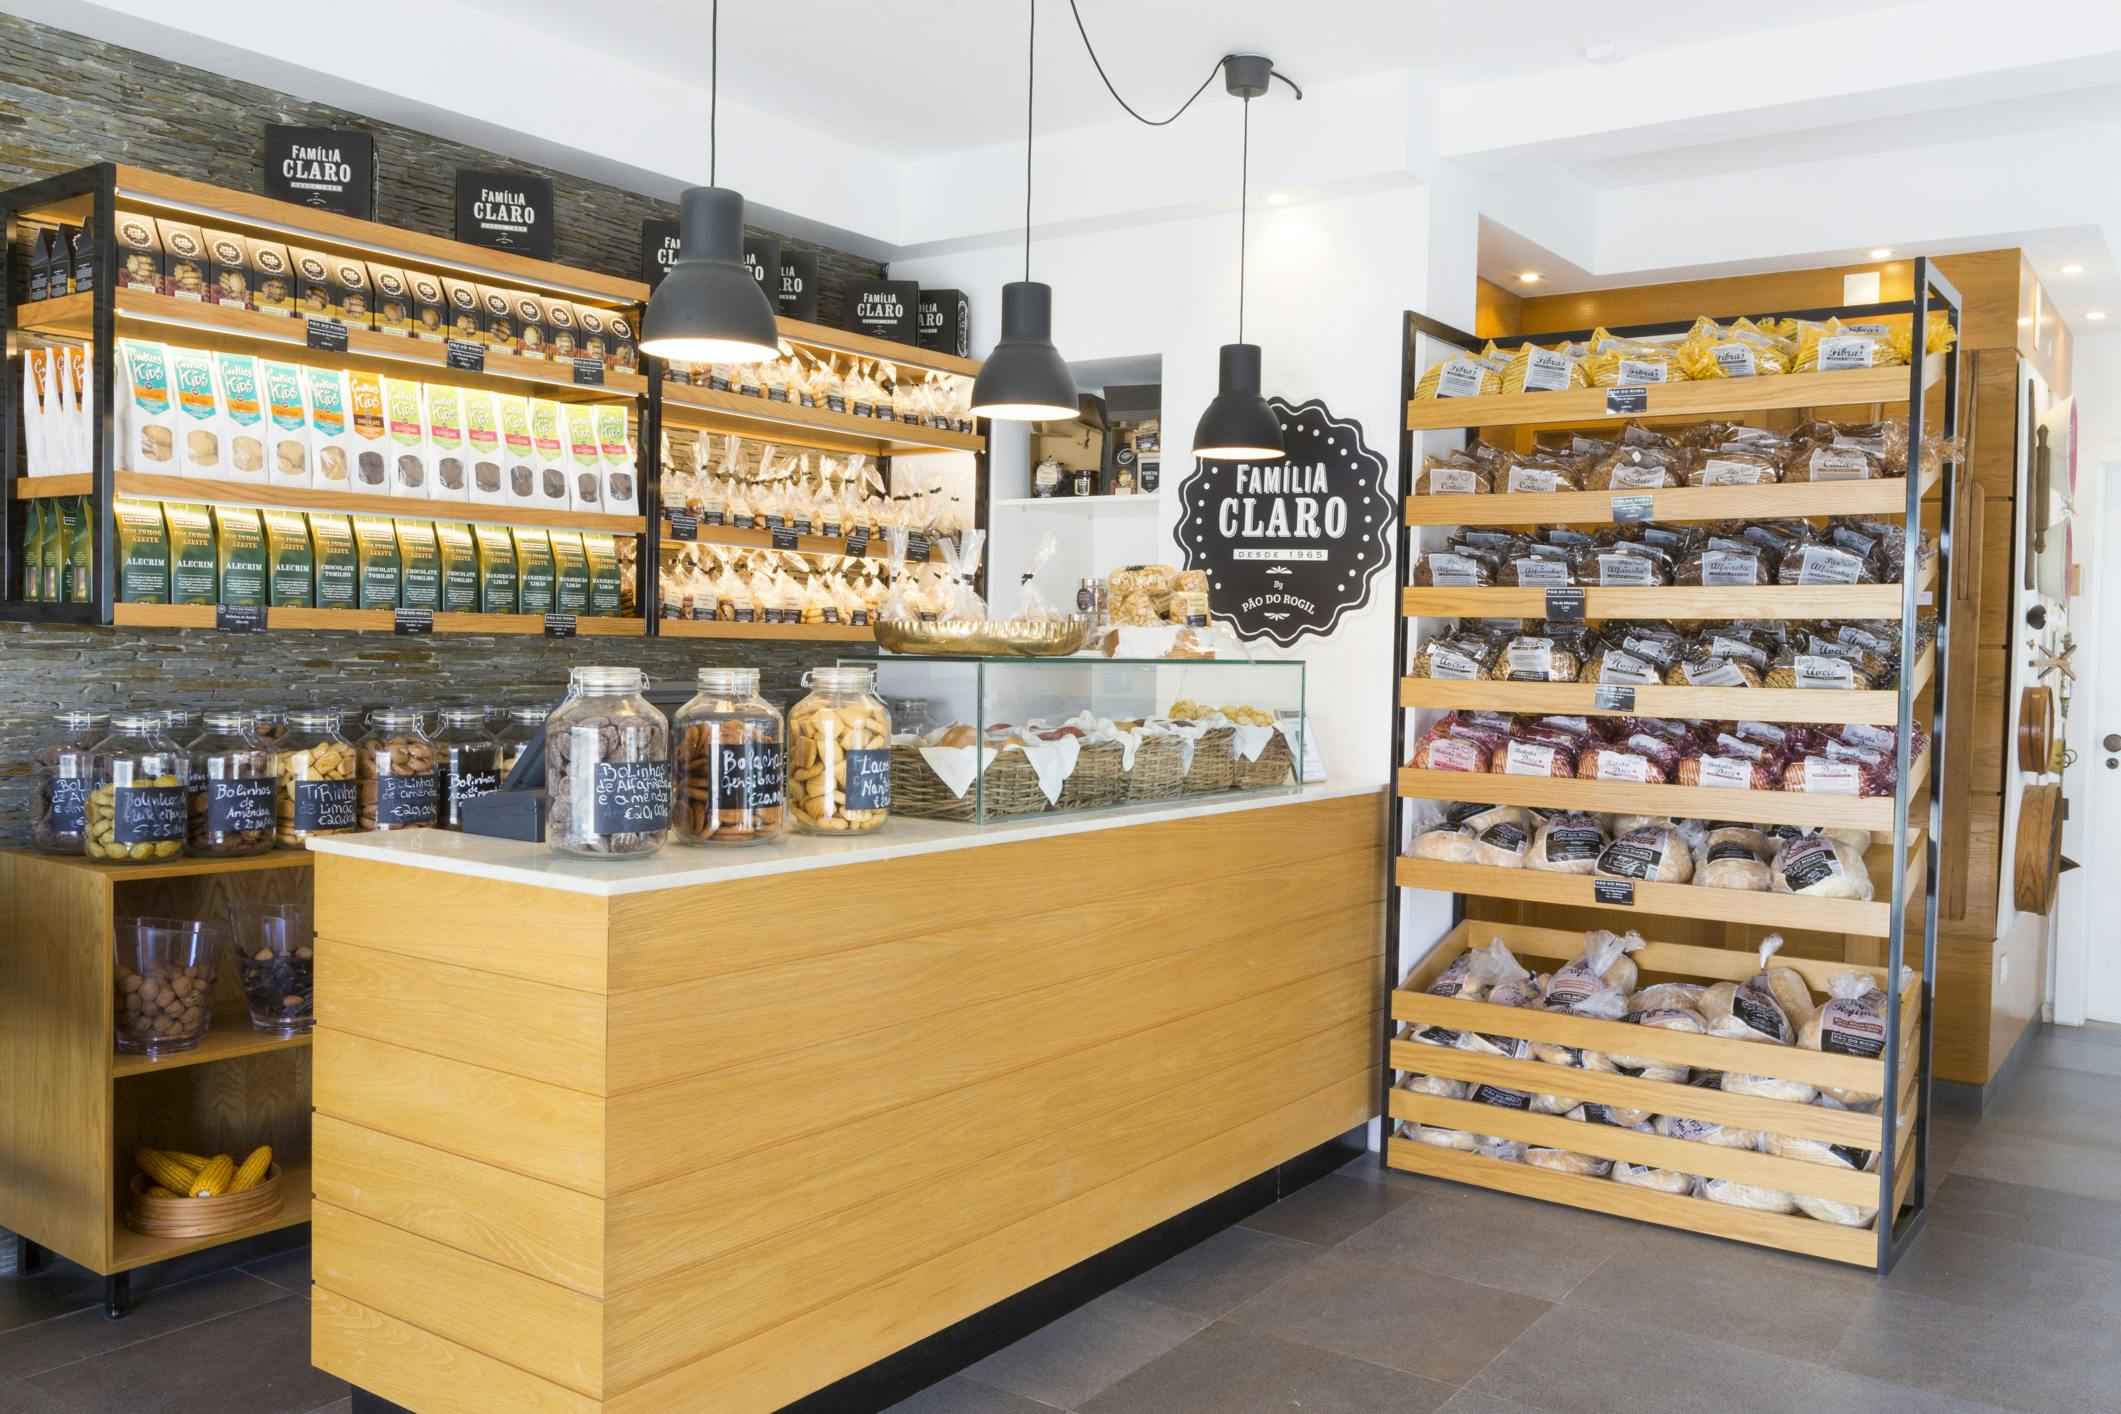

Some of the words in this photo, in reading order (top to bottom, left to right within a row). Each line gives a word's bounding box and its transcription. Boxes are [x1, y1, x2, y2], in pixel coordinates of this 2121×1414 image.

[292, 144, 342, 163] FAMÍLIA
[282, 159, 352, 183] CLARO
[481, 188, 526, 206] FAMÍLIA
[473, 201, 535, 224] CLARO
[863, 292, 897, 304] FAMÍLIA
[857, 303, 904, 318] CLARO
[1236, 460, 1329, 495] FAMÍLIA
[1218, 496, 1348, 539] CLARO
[1238, 551, 1280, 559] DESDE
[1289, 551, 1323, 559] 1965
[127, 558, 165, 567] ALECRIM
[176, 560, 213, 569] ALECRIM
[226, 562, 262, 571] ALECRIM
[275, 564, 309, 572] ALECRIM
[320, 564, 355, 572] CHOCOLATE
[364, 566, 398, 574] CHOCOLATE
[405, 568, 438, 576] CHOCOLATE
[447, 570, 476, 578] CHOCOLATE
[1273, 580, 1284, 591] By
[1241, 597, 1263, 613] PÃO
[1265, 594, 1281, 604] DO
[1283, 594, 1316, 616] ROGIL
[448, 771, 495, 790] Bolinhos
[596, 779, 614, 793] de
[215, 781, 272, 800] Bolinhos
[239, 797, 254, 808] de
[598, 795, 608, 805] e
[320, 800, 353, 814] Limão
